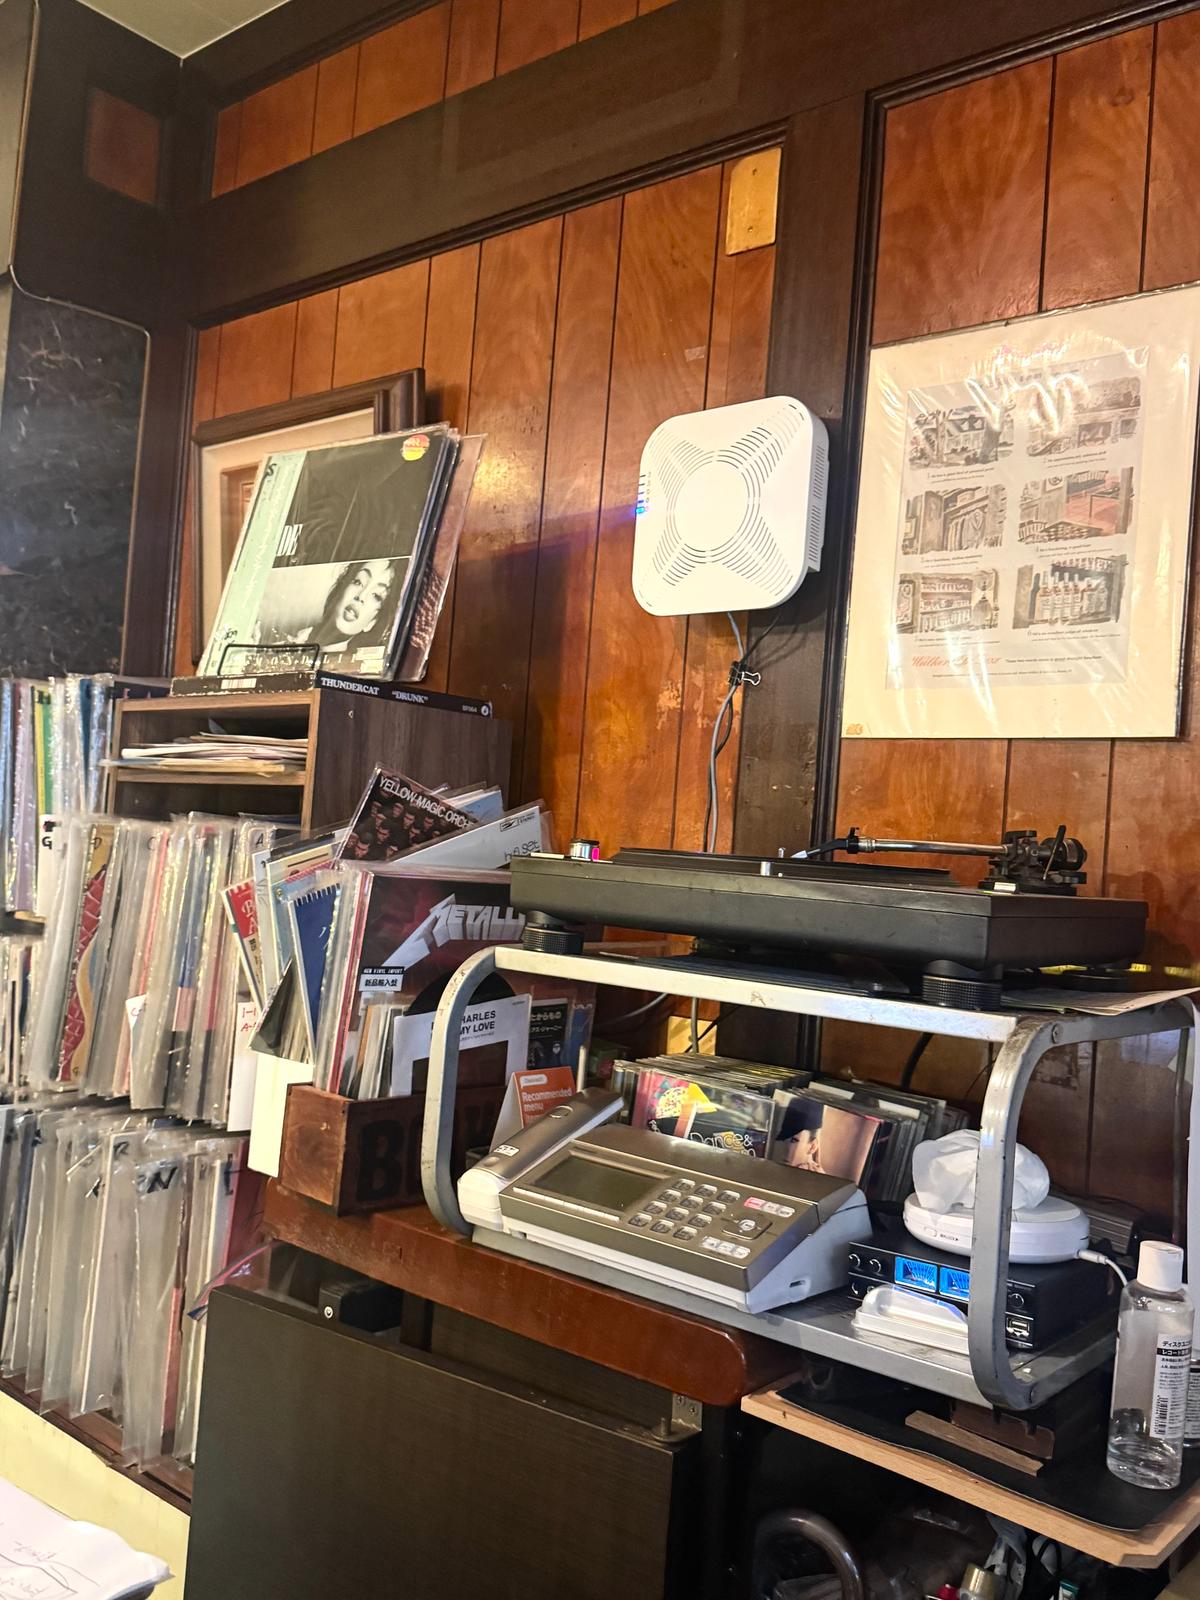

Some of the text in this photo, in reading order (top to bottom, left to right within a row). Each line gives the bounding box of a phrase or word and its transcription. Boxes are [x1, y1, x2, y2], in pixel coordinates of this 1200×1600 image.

[321, 677, 380, 695] THUNDERCAT
[379, 776, 418, 804] YELLOW
[416, 796, 446, 818] MAGIC
[461, 1010, 496, 1024] HARLES
[473, 1021, 495, 1033] LOVE
[522, 1088, 572, 1102] Recommended
[523, 1103, 544, 1112] menu
